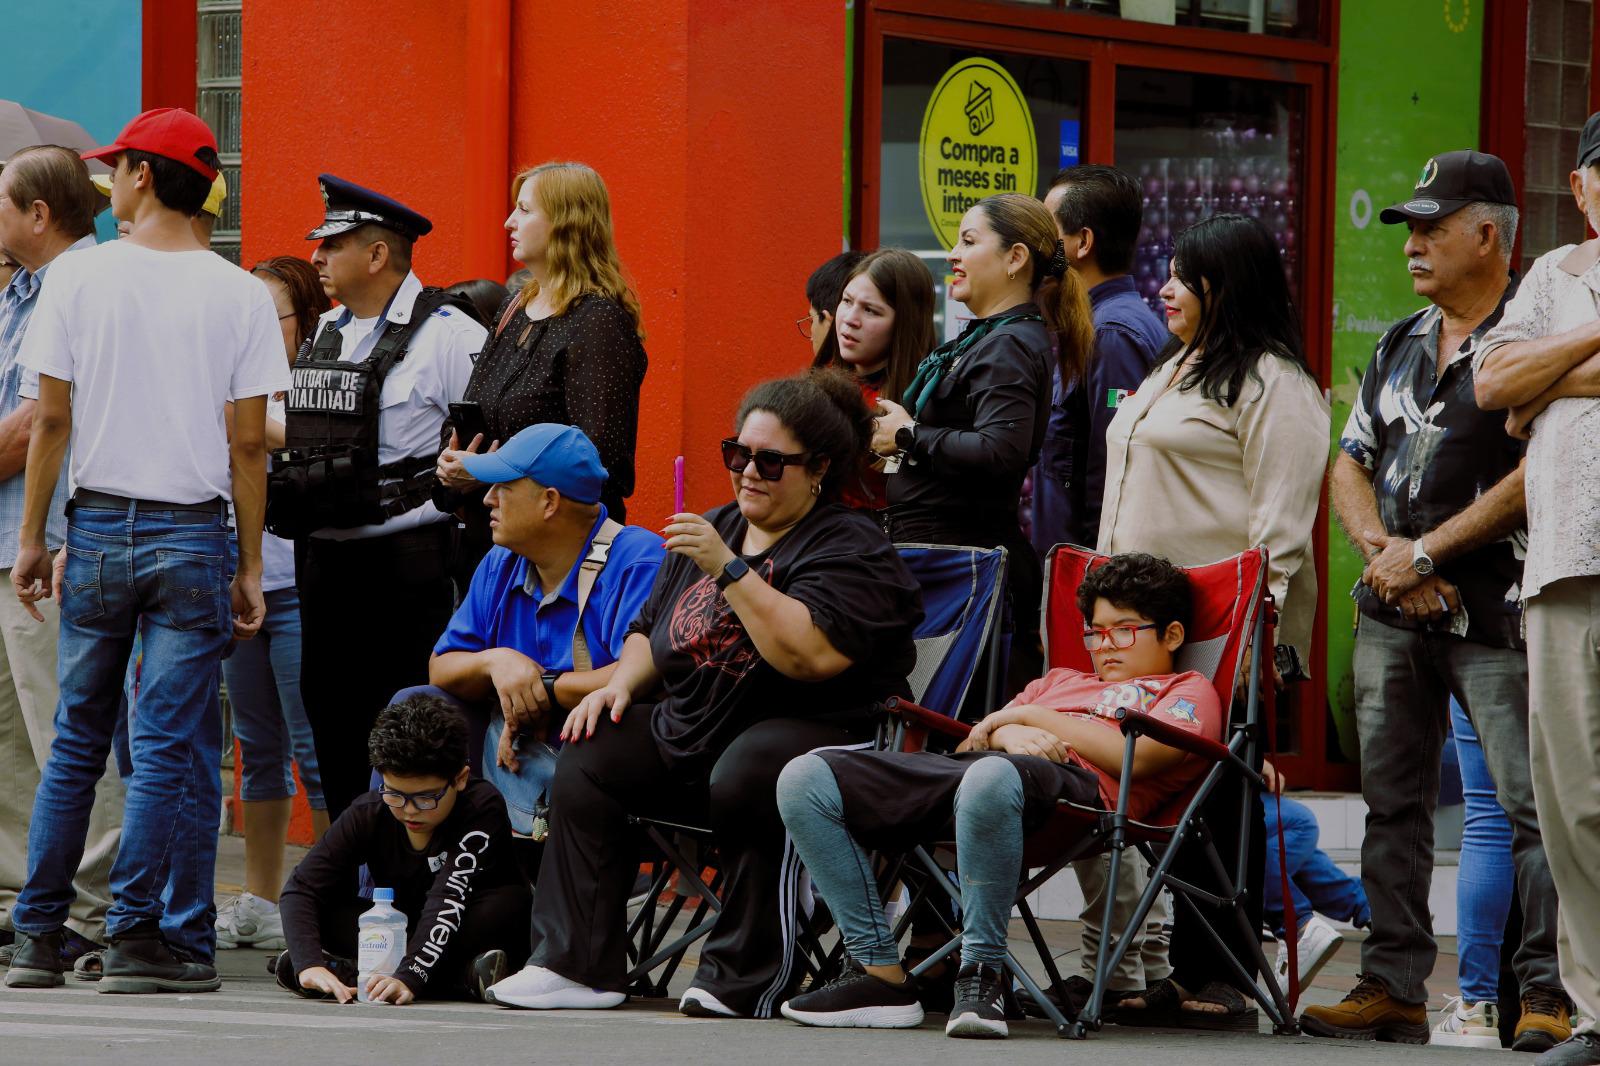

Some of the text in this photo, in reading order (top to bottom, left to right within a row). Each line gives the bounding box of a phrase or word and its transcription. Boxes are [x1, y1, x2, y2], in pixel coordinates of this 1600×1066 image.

[940, 136, 1019, 166] Compra a
[1061, 145, 1078, 157] VISA
[938, 167, 1017, 191] meses sin
[943, 189, 980, 213] inter
[340, 371, 361, 391] DE
[414, 830, 490, 969] Cavin Klein
